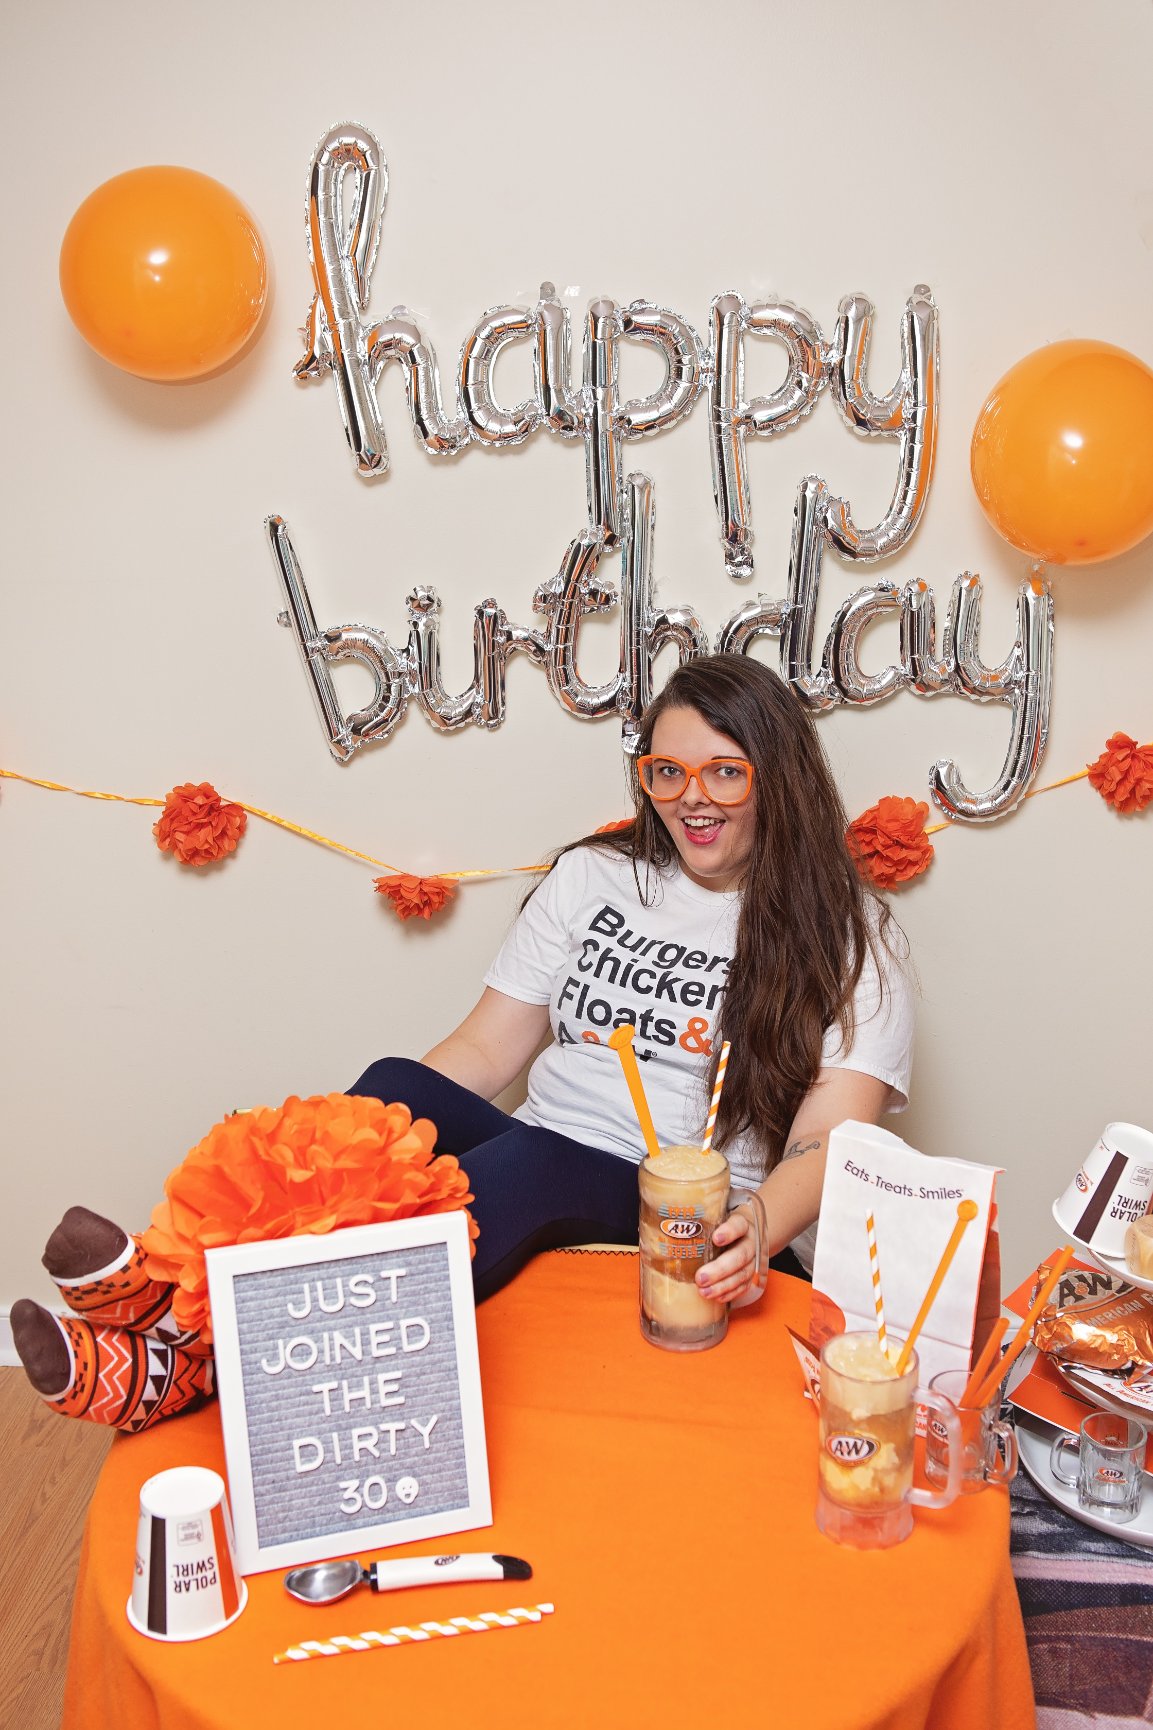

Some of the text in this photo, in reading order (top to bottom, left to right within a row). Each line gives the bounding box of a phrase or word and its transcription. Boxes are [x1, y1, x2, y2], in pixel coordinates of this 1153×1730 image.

[292, 120, 942, 578] happy
[263, 470, 1056, 826] birthday
[844, 1160, 963, 1200] Eats Treats Smiles
[1117, 1194, 1148, 1211] SWIRL
[287, 1269, 407, 1319] JUST
[261, 1316, 431, 1375] JOINED
[312, 1371, 406, 1416] THE
[293, 1414, 439, 1473] DIRTY
[339, 1475, 388, 1514] 30
[173, 1556, 215, 1578] SWIRL
[174, 1573, 217, 1594] POLAR
